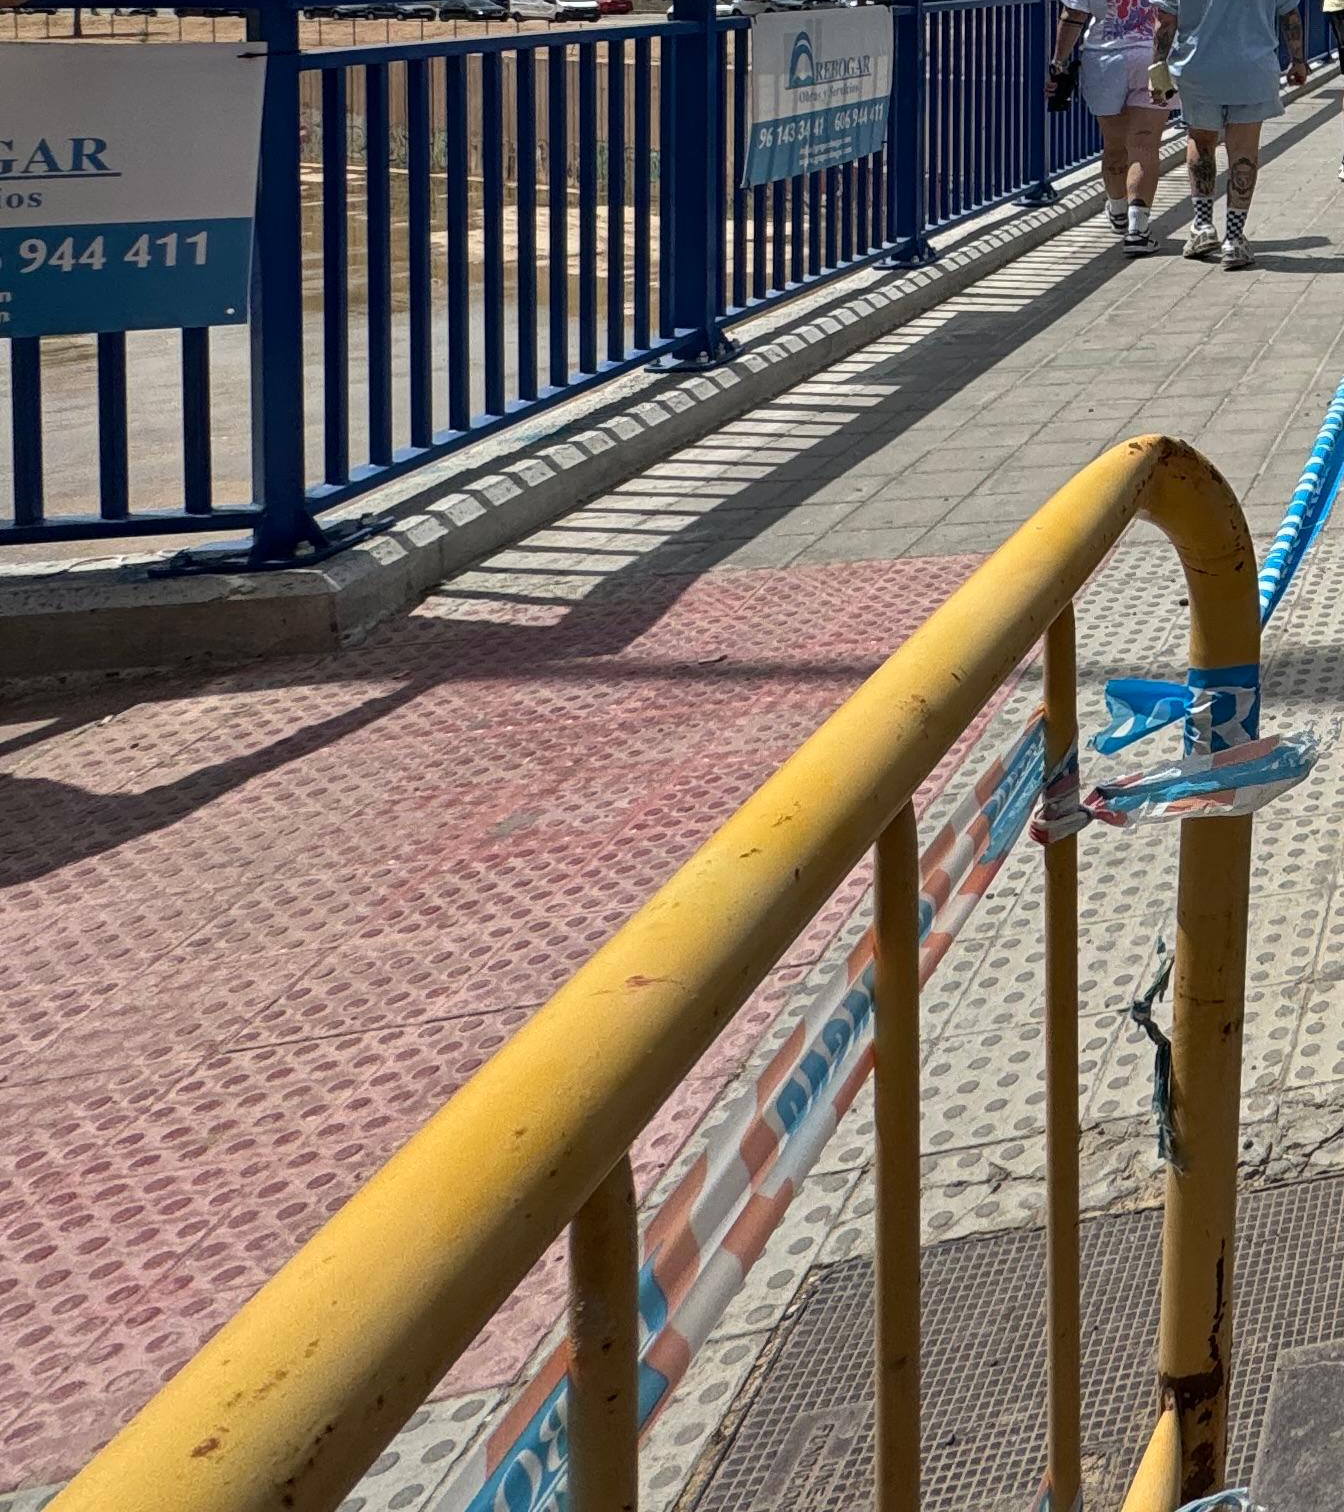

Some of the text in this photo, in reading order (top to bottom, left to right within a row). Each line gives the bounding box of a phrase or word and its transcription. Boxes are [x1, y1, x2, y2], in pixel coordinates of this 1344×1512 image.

[759, 126, 773, 149] 96
[777, 122, 796, 145] 143
[798, 118, 811, 141] 34
[813, 116, 824, 137] 41
[834, 109, 850, 132] 606
[19, 231, 208, 274] 944 411
